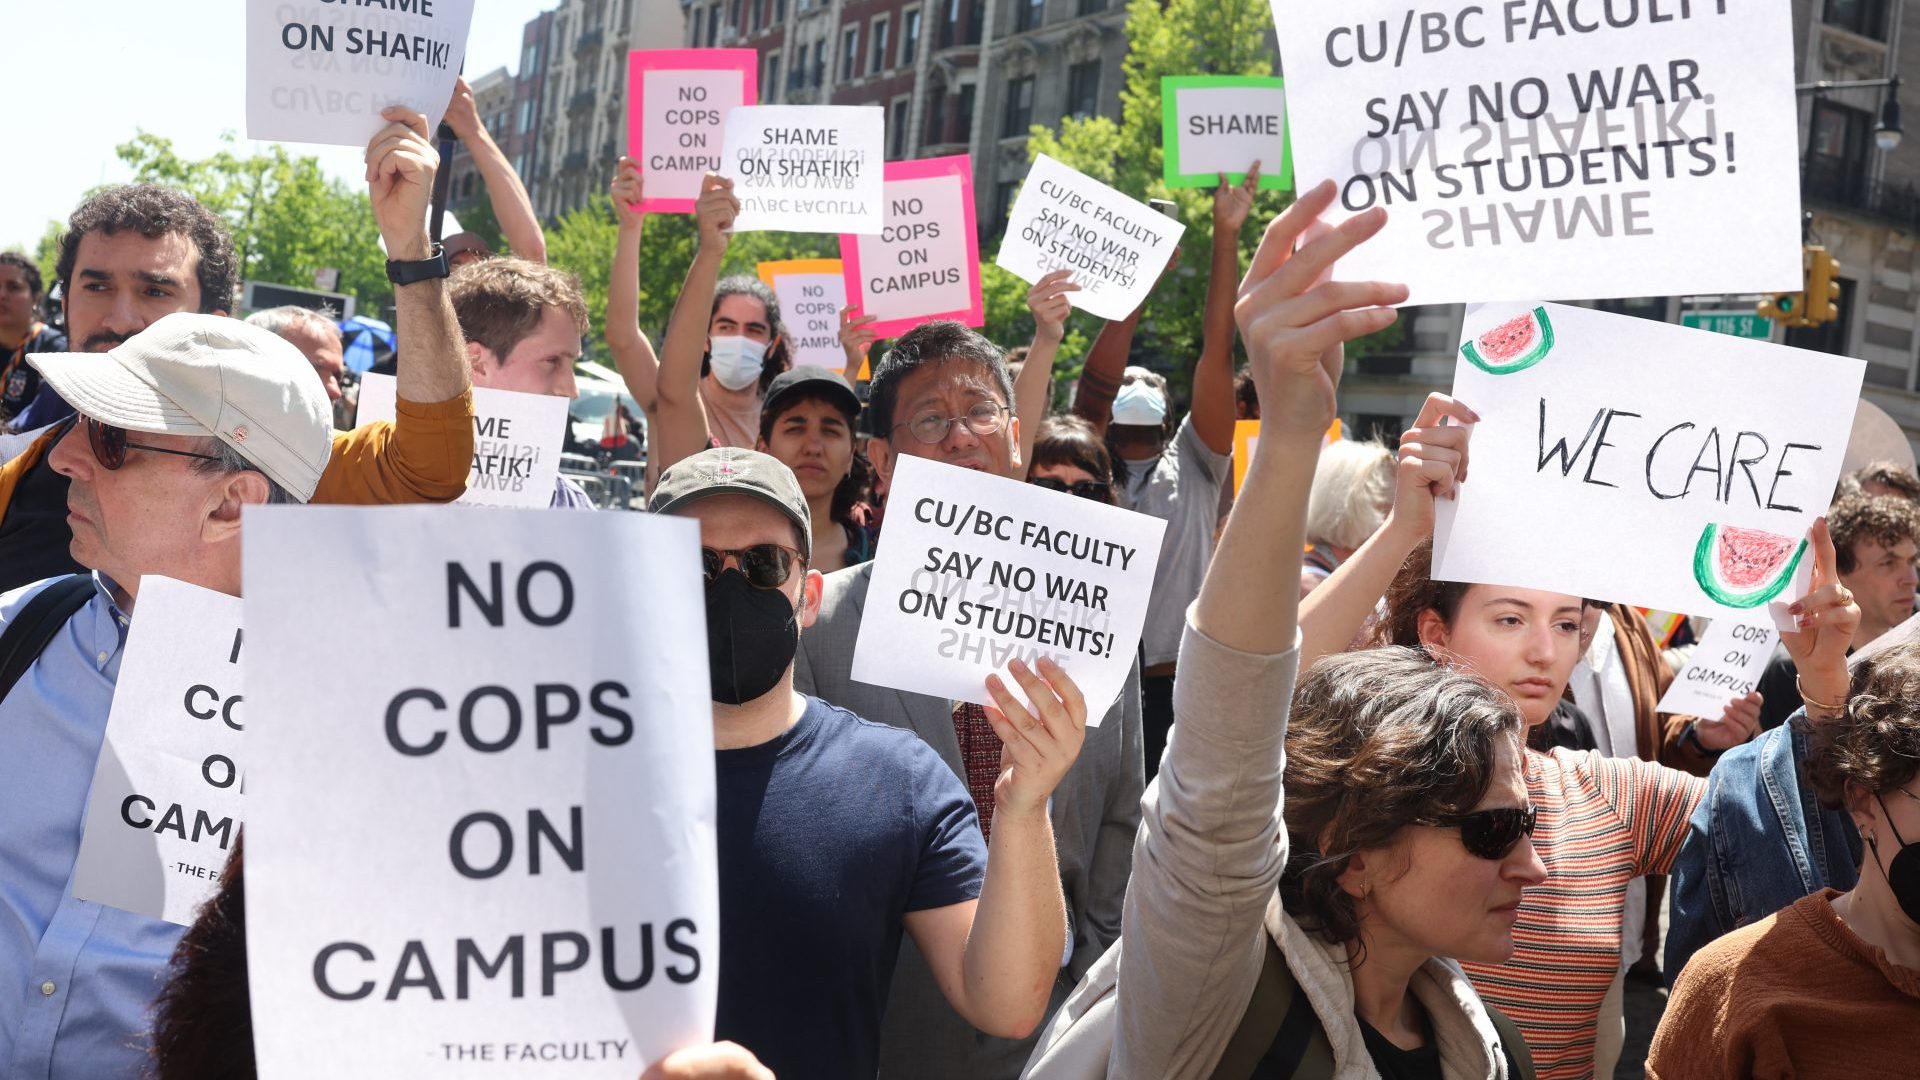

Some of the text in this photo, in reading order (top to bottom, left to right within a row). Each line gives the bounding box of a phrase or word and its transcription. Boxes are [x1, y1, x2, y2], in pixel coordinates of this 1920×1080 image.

[282, 23, 450, 70] ON SHAFIK!
[1325, 5, 1486, 68] CU/BC
[679, 86, 707, 102] NO
[1365, 58, 1703, 138] SAY NO WAR
[665, 109, 721, 126] COPS
[1189, 115, 1279, 136] SHAME
[679, 132, 706, 148] ON
[762, 128, 838, 146] SHAME
[650, 155, 721, 172] CAMPU
[740, 158, 860, 178] ON SHAFIK!
[1341, 131, 1737, 212] ON STUDENTS!
[892, 198, 923, 216] NO
[1040, 180, 1162, 247] CU/BC FACULTY
[881, 222, 940, 243] COPS
[1038, 207, 1140, 265] SAY NO WAR
[898, 248, 928, 266] ON
[1022, 227, 1136, 289] ON STUDENTS!
[802, 285, 824, 298] NO
[870, 267, 960, 294] CAMPUS
[795, 302, 836, 315] COPS
[807, 319, 828, 332] ON
[793, 336, 841, 349] CAMPU
[471, 454, 533, 478] AFIK!
[1537, 397, 1822, 513] WE CARE
[914, 497, 1136, 571] CU/BC FACULTY
[924, 547, 1108, 611] SAY NO WAR
[446, 560, 575, 628] NO
[899, 589, 1115, 659] ON STUDENTS!
[1732, 624, 1770, 644] COPS
[1724, 650, 1752, 668] ON
[1687, 666, 1753, 695] CAMPUS
[184, 684, 245, 731] CO
[385, 680, 635, 757] COPS
[201, 754, 246, 795] O
[120, 794, 234, 850] CAM
[449, 806, 585, 880] ON
[176, 861, 206, 880] THE
[312, 918, 701, 1001] CAMPUS
[442, 1044, 495, 1061] THE
[505, 1040, 629, 1061] FACULTY
